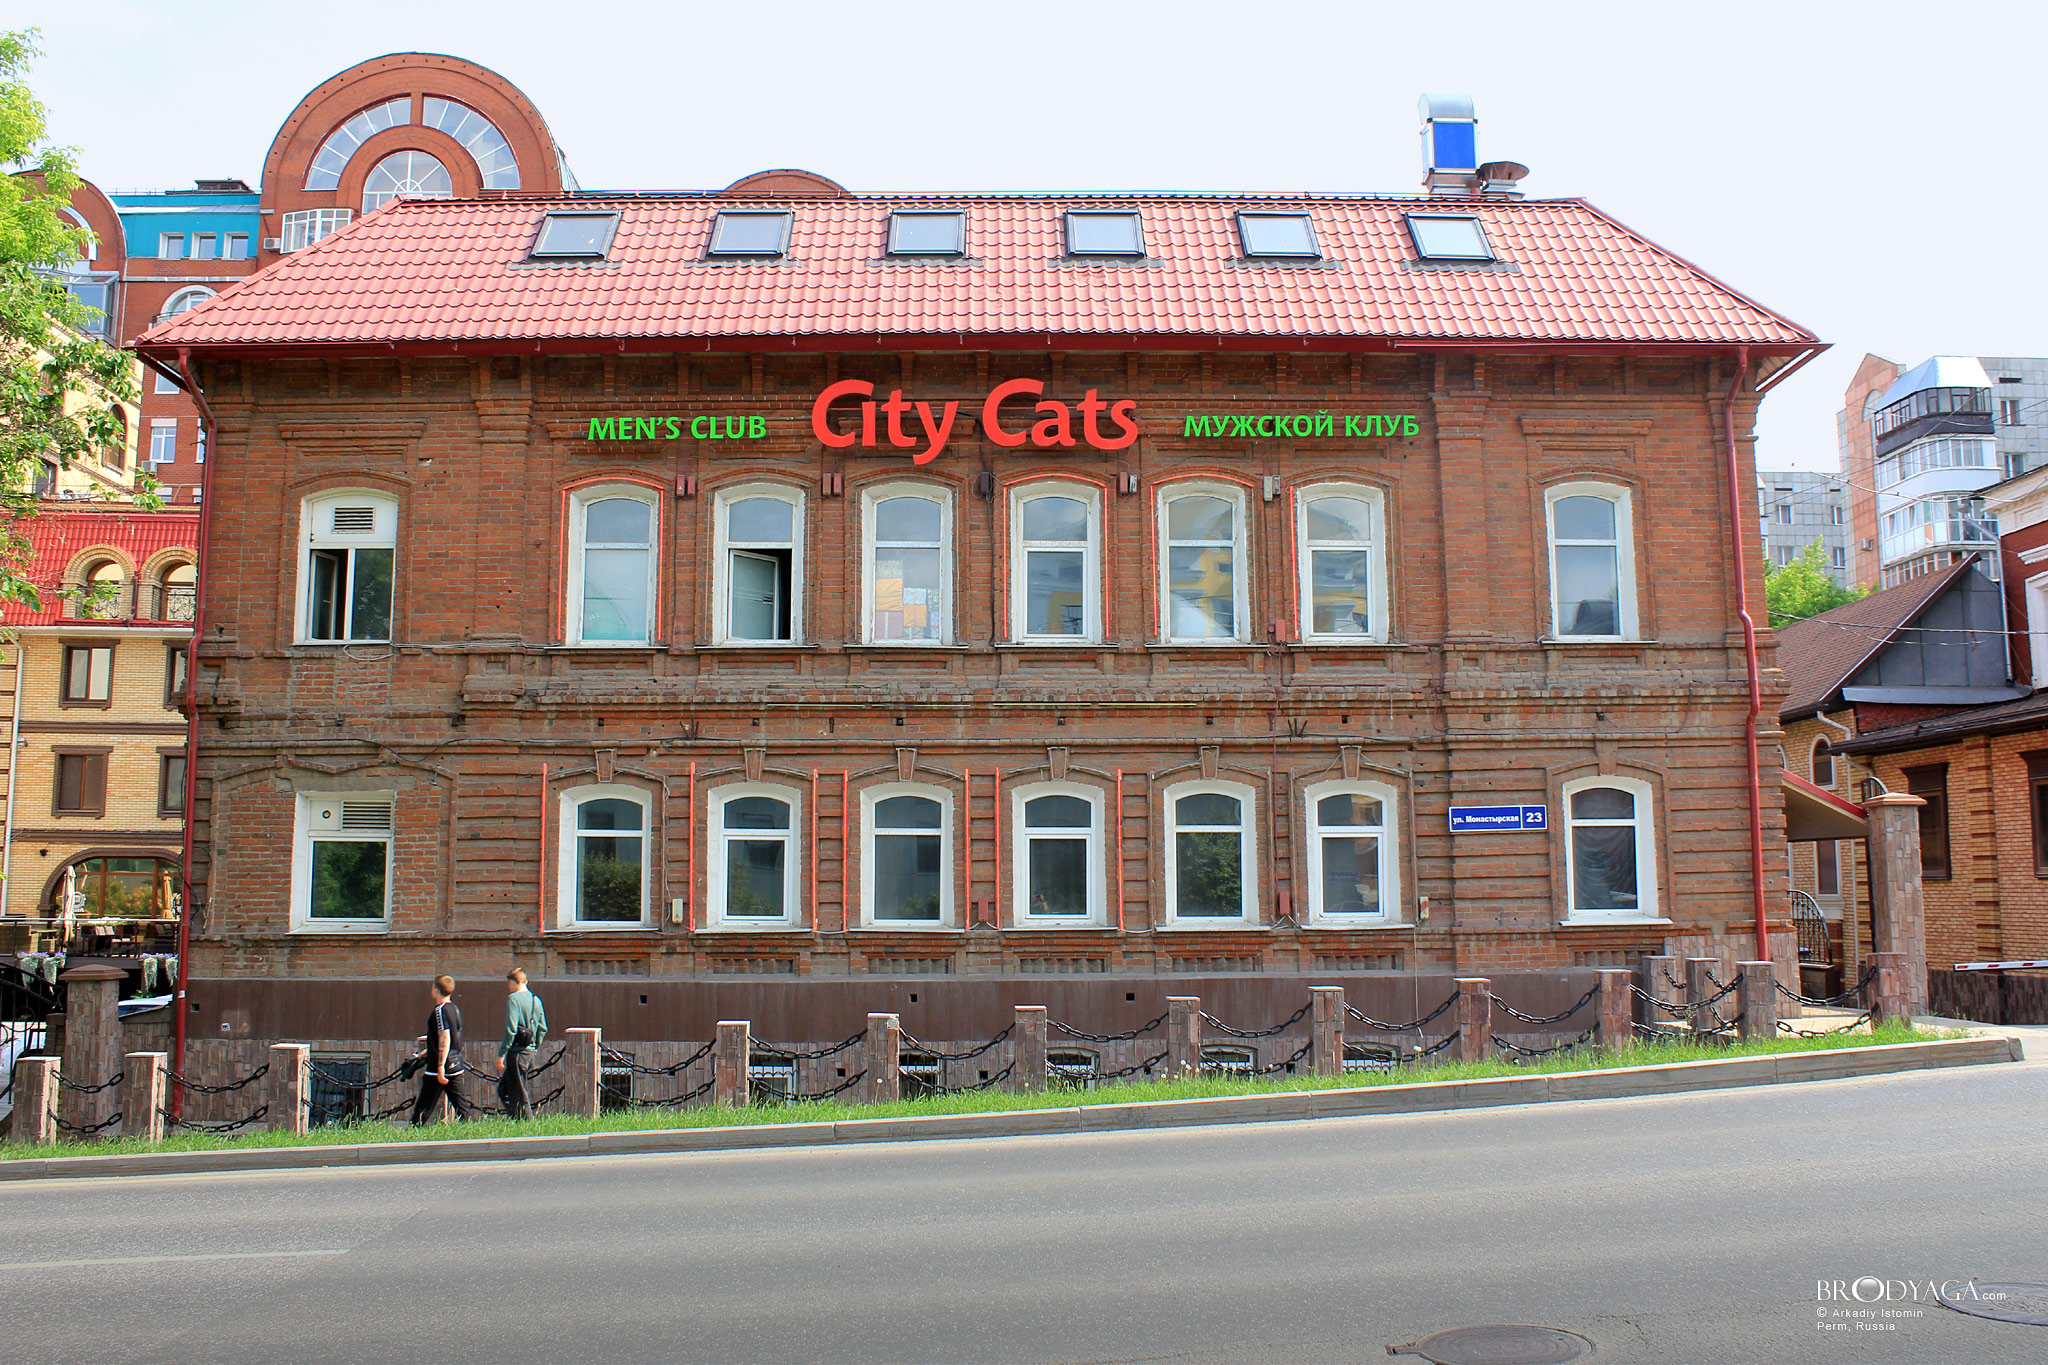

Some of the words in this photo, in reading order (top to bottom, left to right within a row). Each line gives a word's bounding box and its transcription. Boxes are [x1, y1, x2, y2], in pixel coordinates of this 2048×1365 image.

[587, 416, 681, 441] MEN'S
[690, 415, 767, 440] CLUB
[811, 379, 959, 465] City
[982, 378, 1139, 449] Cats
[1185, 409, 1334, 438] МУЖСКОЙ
[1344, 415, 1420, 438] КЛУБ
[1452, 816, 1464, 825] ул.
[1465, 815, 1519, 824] Монастырская
[1525, 812, 1543, 823] 23
